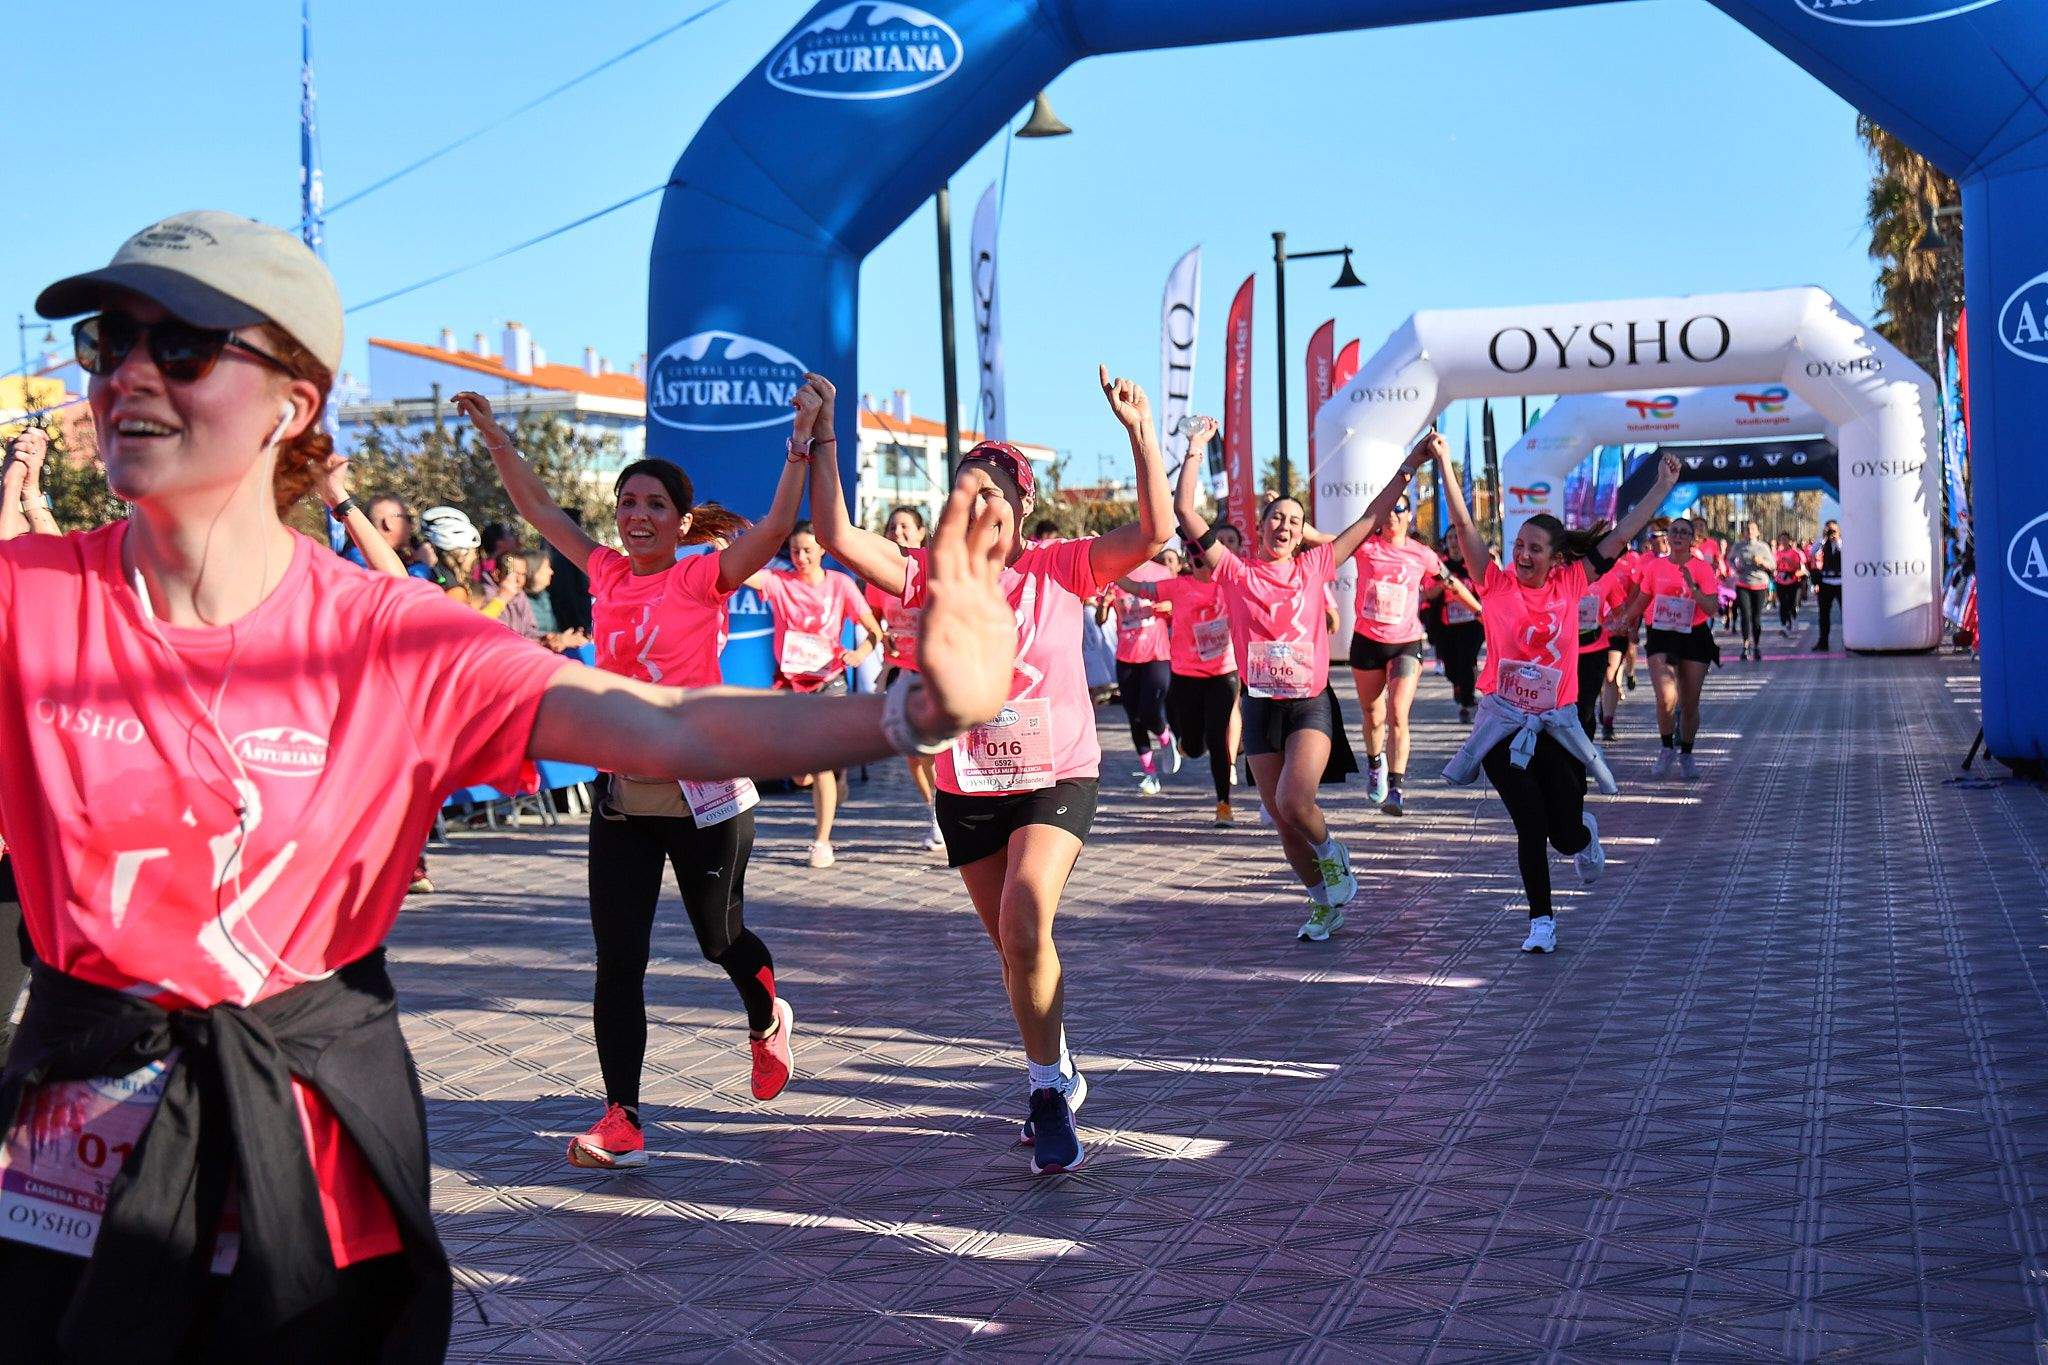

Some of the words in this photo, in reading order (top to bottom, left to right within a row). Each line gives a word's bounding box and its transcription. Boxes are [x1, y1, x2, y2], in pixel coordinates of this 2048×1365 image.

[871, 29, 940, 41] LECHERA
[777, 43, 947, 79] ASTURIANA
[1488, 313, 1731, 374] OYSHO
[1806, 358, 1882, 379] OYSHO
[1350, 387, 1419, 404] OYSHO
[1685, 451, 1808, 471] VOLVO
[1854, 560, 1926, 577] OYSHO
[1270, 667, 1293, 677] 016
[1516, 686, 1538, 699] 016
[36, 698, 144, 745] OYSHO
[986, 741, 1022, 756] 016
[706, 806, 733, 821] OYSHO
[9, 1205, 92, 1239] OYSHO
